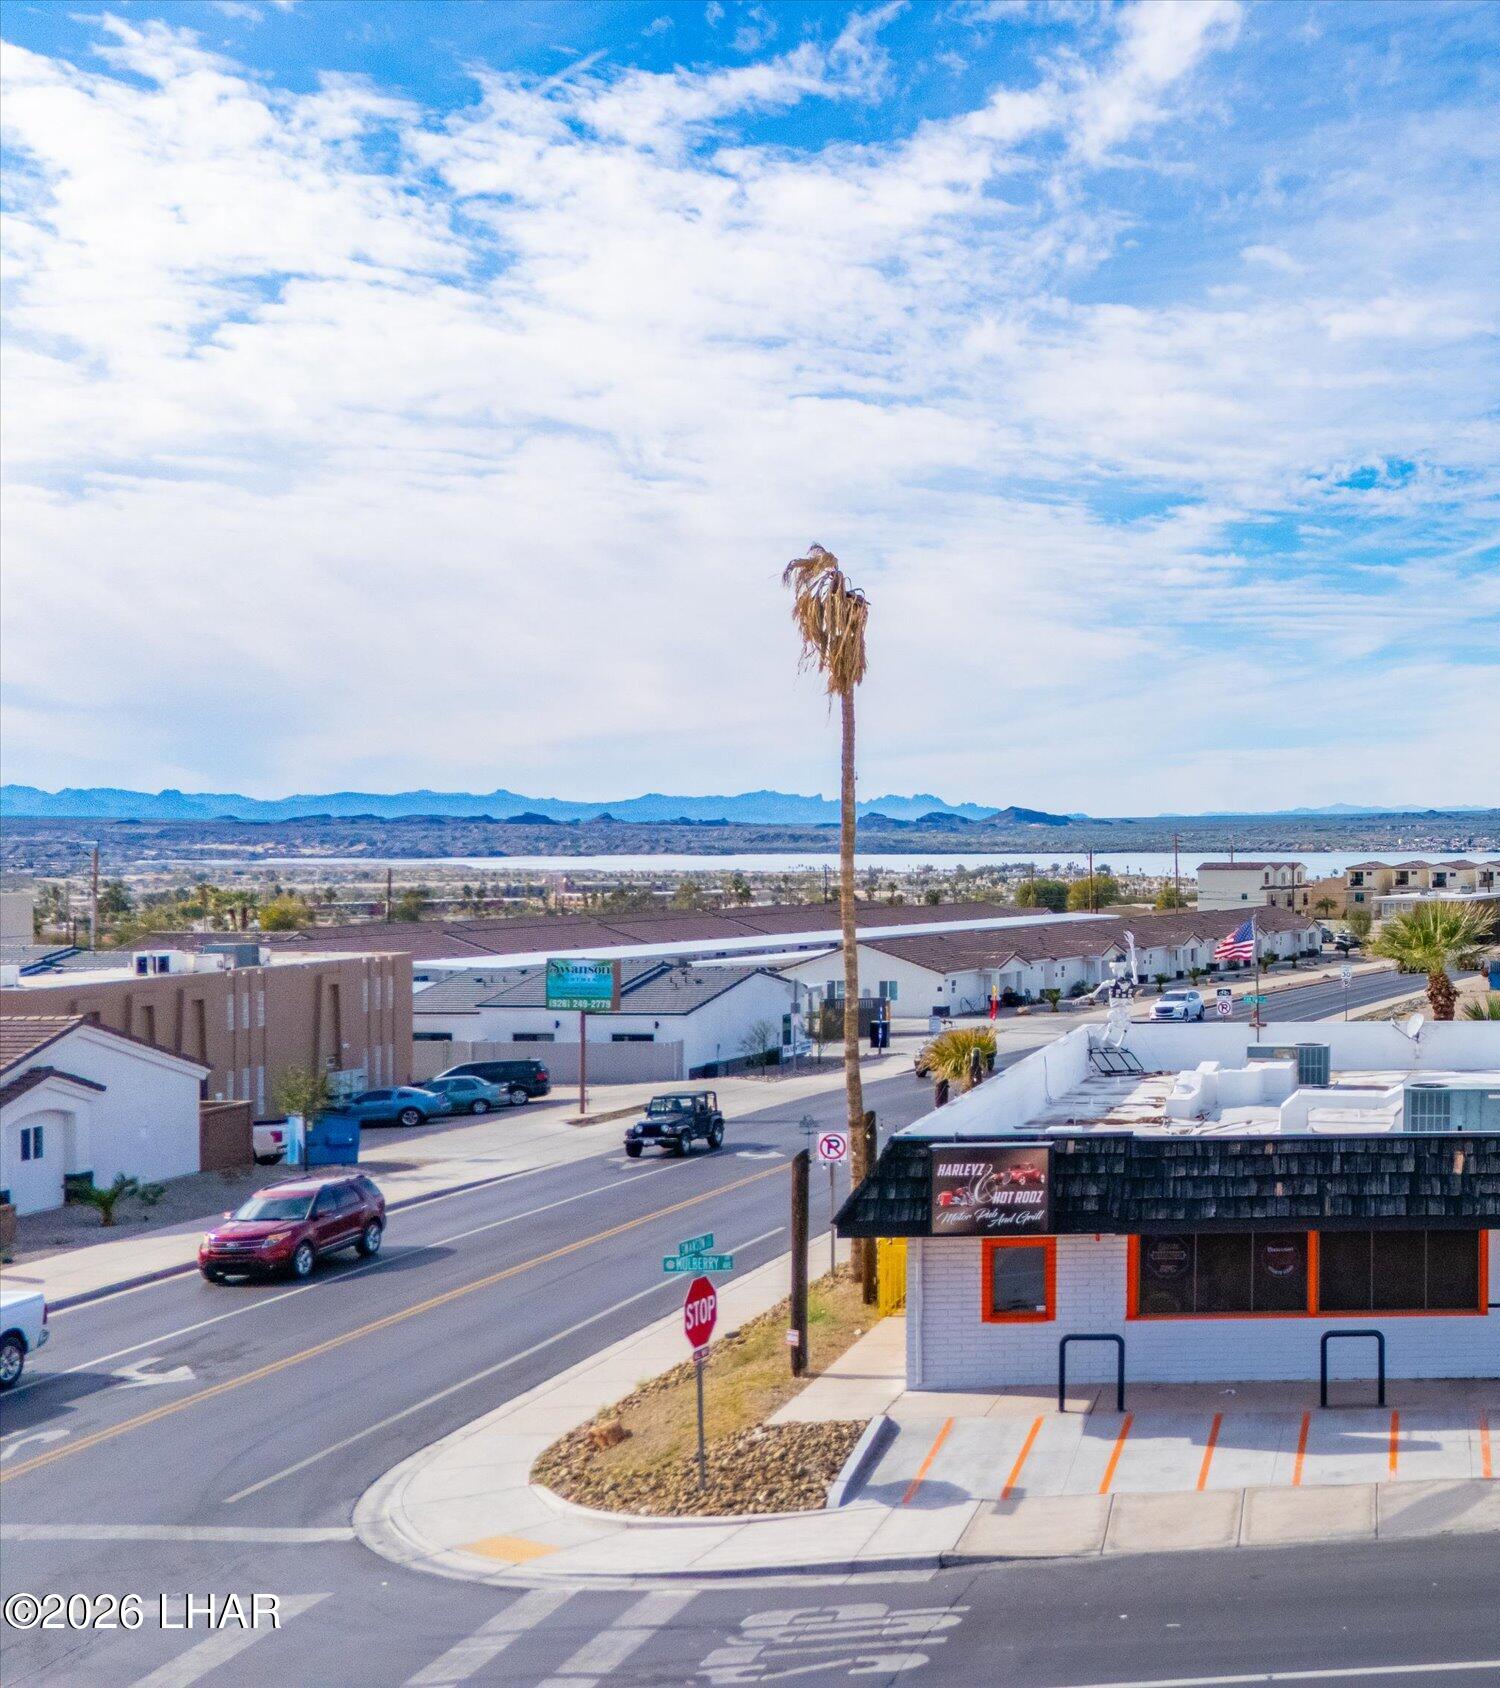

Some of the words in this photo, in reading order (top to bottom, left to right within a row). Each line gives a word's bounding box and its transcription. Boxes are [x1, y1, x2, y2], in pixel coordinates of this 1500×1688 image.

[550, 962, 610, 976] Swanson
[937, 1163, 985, 1177] HARLEYZ
[992, 1191, 1014, 1204] HOT
[1015, 1190, 1044, 1204] RODZ
[937, 1211, 972, 1224] Motor
[974, 1208, 998, 1219] Pub
[987, 1213, 1015, 1228] And
[1016, 1209, 1045, 1225] Grill
[676, 1256, 719, 1270] MULBERRY
[686, 1294, 715, 1330] STOP
